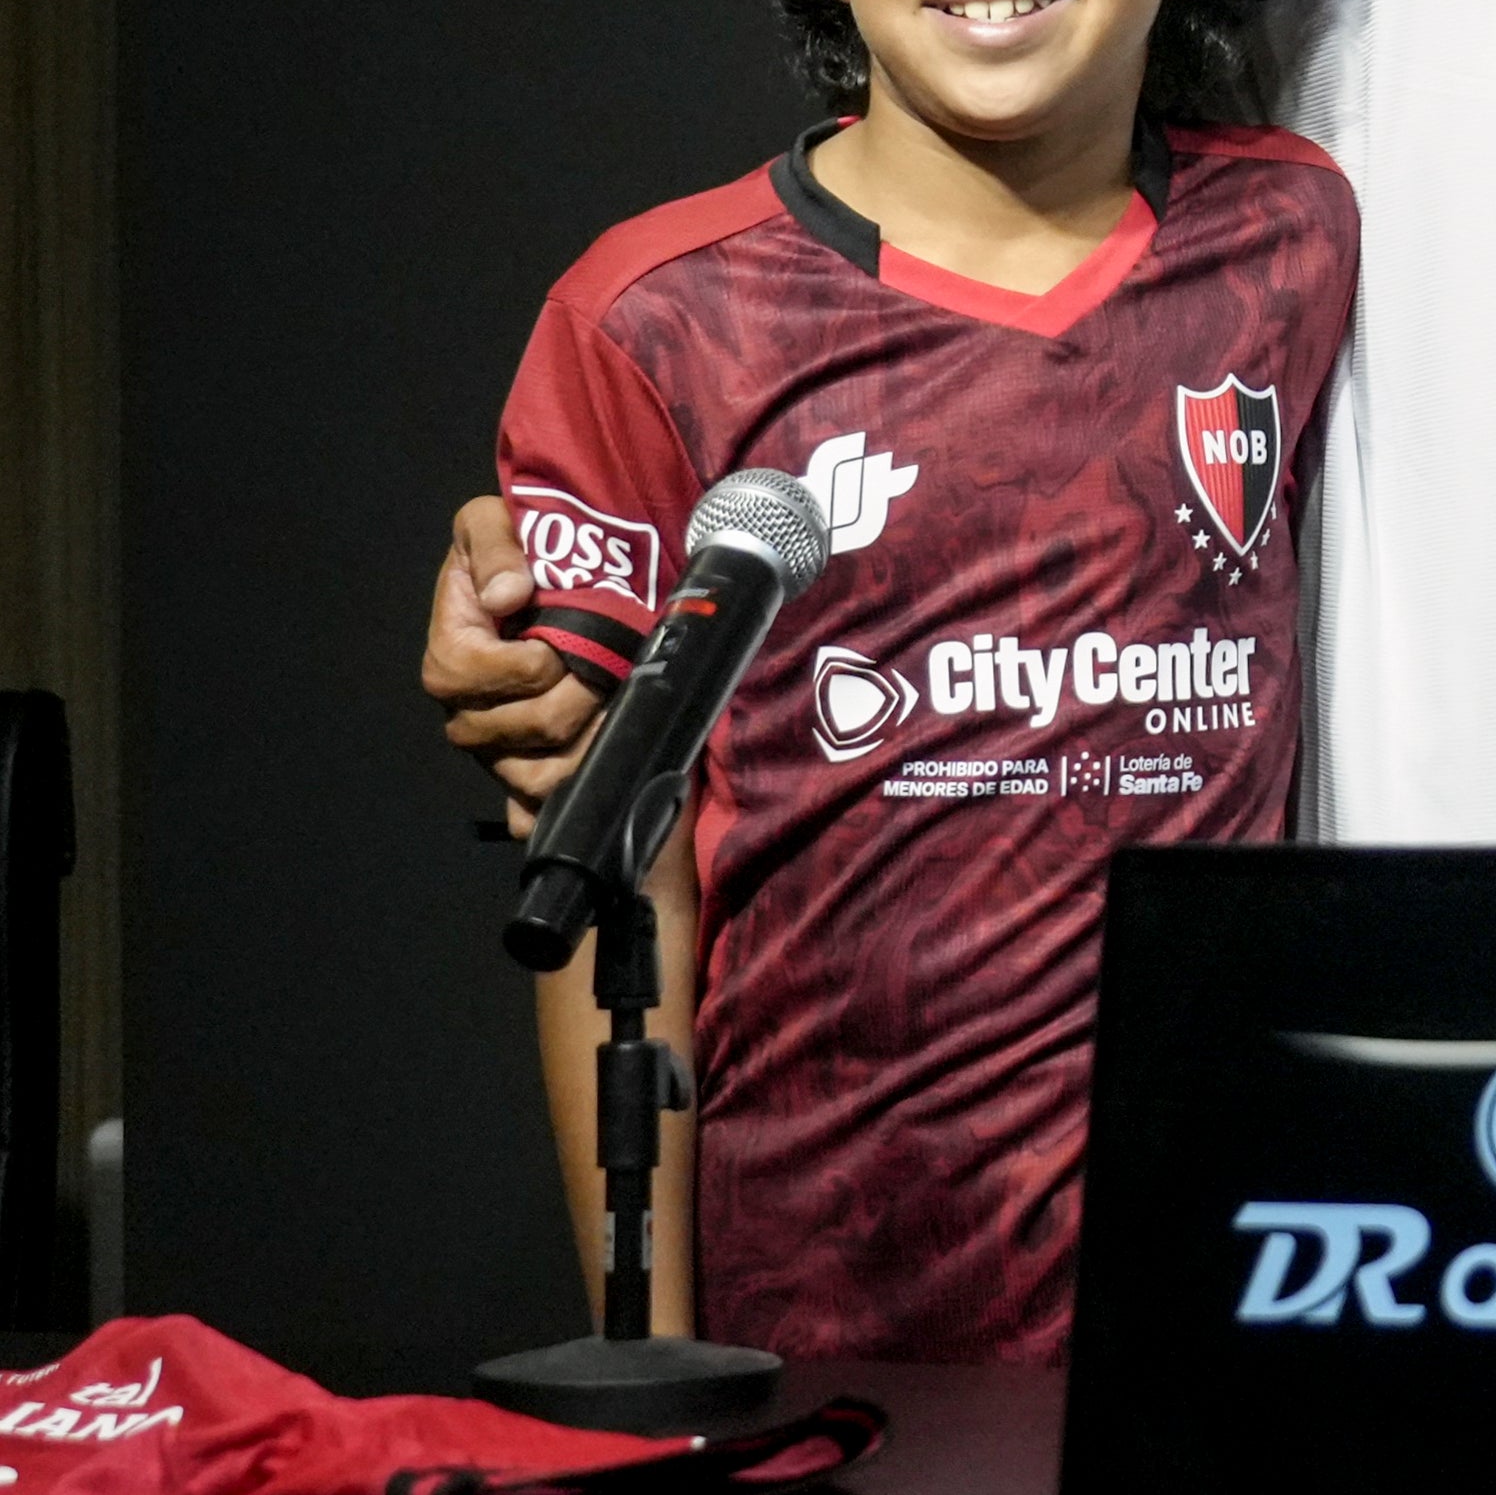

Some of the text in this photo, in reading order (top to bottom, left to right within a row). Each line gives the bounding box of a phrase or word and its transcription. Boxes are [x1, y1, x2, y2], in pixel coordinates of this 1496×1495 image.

[1202, 430, 1267, 465] NOB
[1145, 702, 1256, 735] ONLINE
[902, 758, 1049, 777] PROHIBIDO PARA
[1119, 753, 1193, 772] Lotería de
[883, 777, 1048, 797] MENORES DE EDAD
[1232, 1202, 1432, 1324] DR
